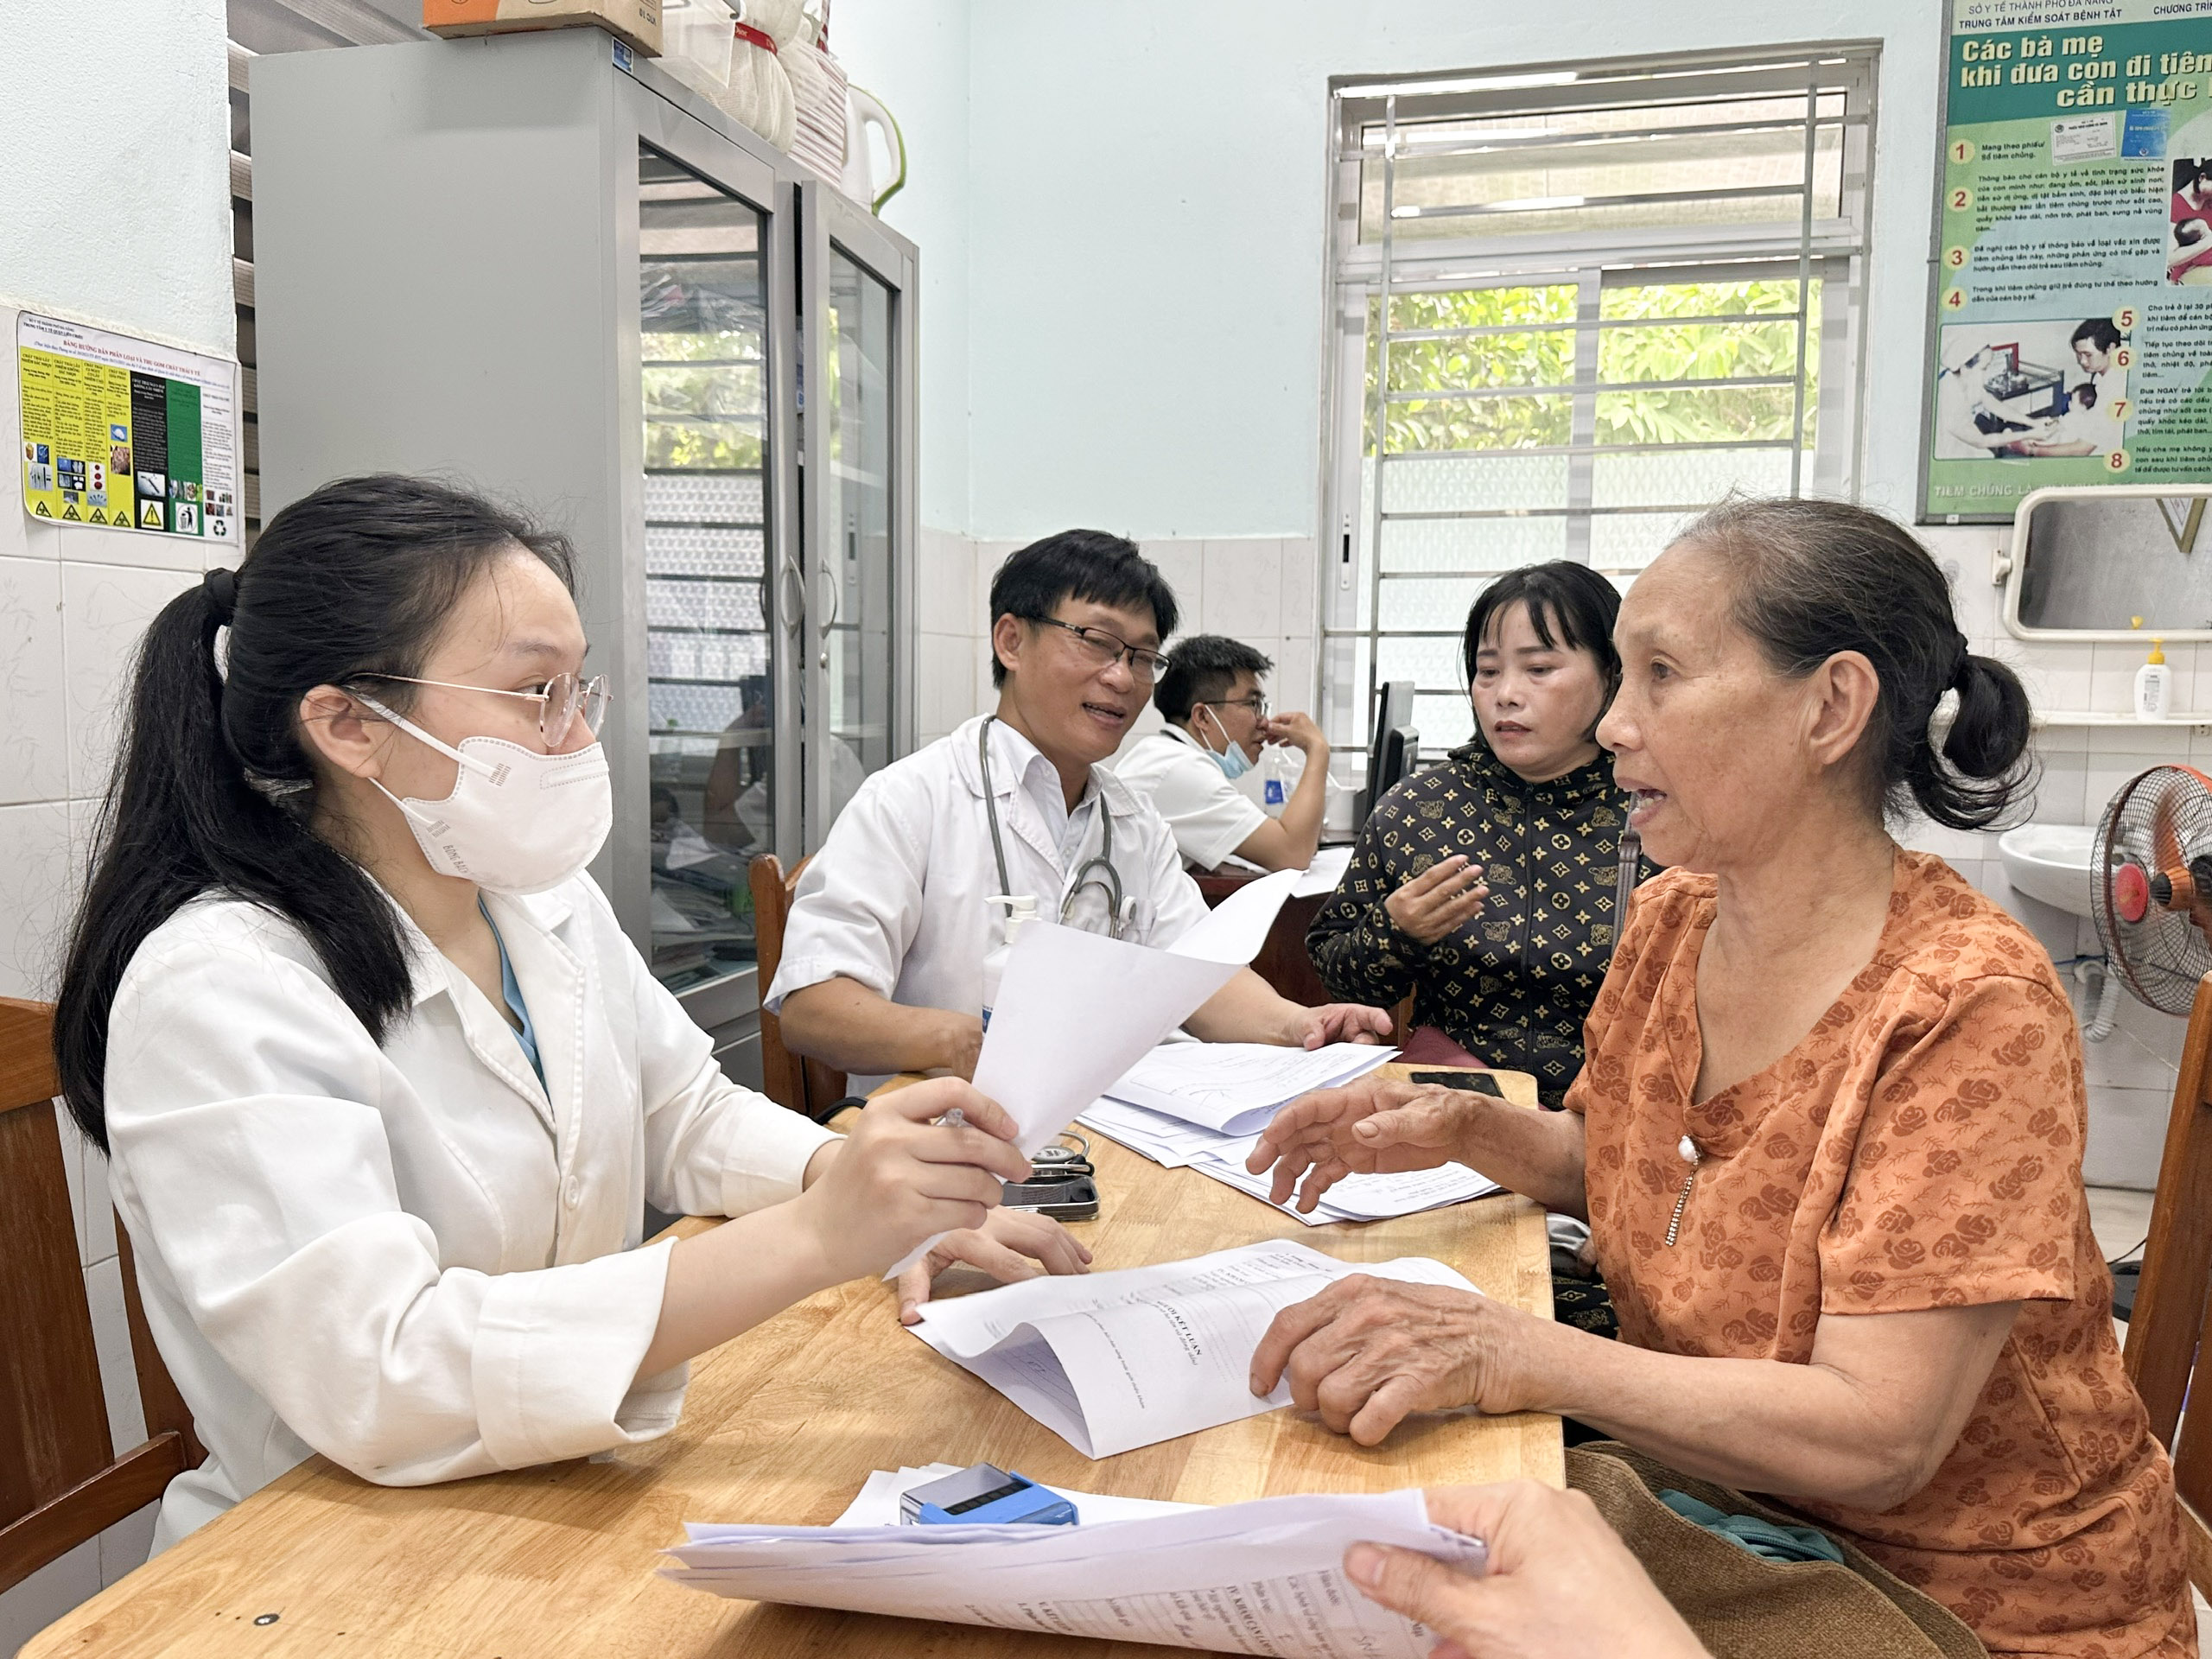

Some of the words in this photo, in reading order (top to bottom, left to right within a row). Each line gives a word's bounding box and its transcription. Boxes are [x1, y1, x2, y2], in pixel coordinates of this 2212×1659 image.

[1960, 19, 1992, 29] TRUNG
[1995, 17, 2015, 26] TÂM
[2018, 11, 2041, 24] KIỂM
[2044, 11, 2070, 22] SOÁT
[2073, 10, 2101, 22] BỆNH
[2103, 7, 2122, 20] TẬT
[1962, 38, 2012, 62] Các
[2020, 35, 2053, 59] bà
[2062, 35, 2103, 58] mẹ
[1961, 64, 2001, 87] khi
[2010, 62, 2058, 84] đưa
[2068, 60, 2116, 81] con
[2126, 54, 2152, 77] đi
[2056, 80, 2115, 108] cần
[2126, 79, 2196, 105] thực
[1955, 144, 1964, 159] 1
[1954, 191, 1967, 207] 2
[1951, 250, 1962, 266] 3
[1948, 292, 1961, 307] 4
[2120, 310, 2133, 327] 5
[2117, 351, 2129, 366] 6
[2114, 402, 2126, 417] 7
[2111, 453, 2122, 468] 8
[1185, 1333, 1203, 1355] LUẬN
